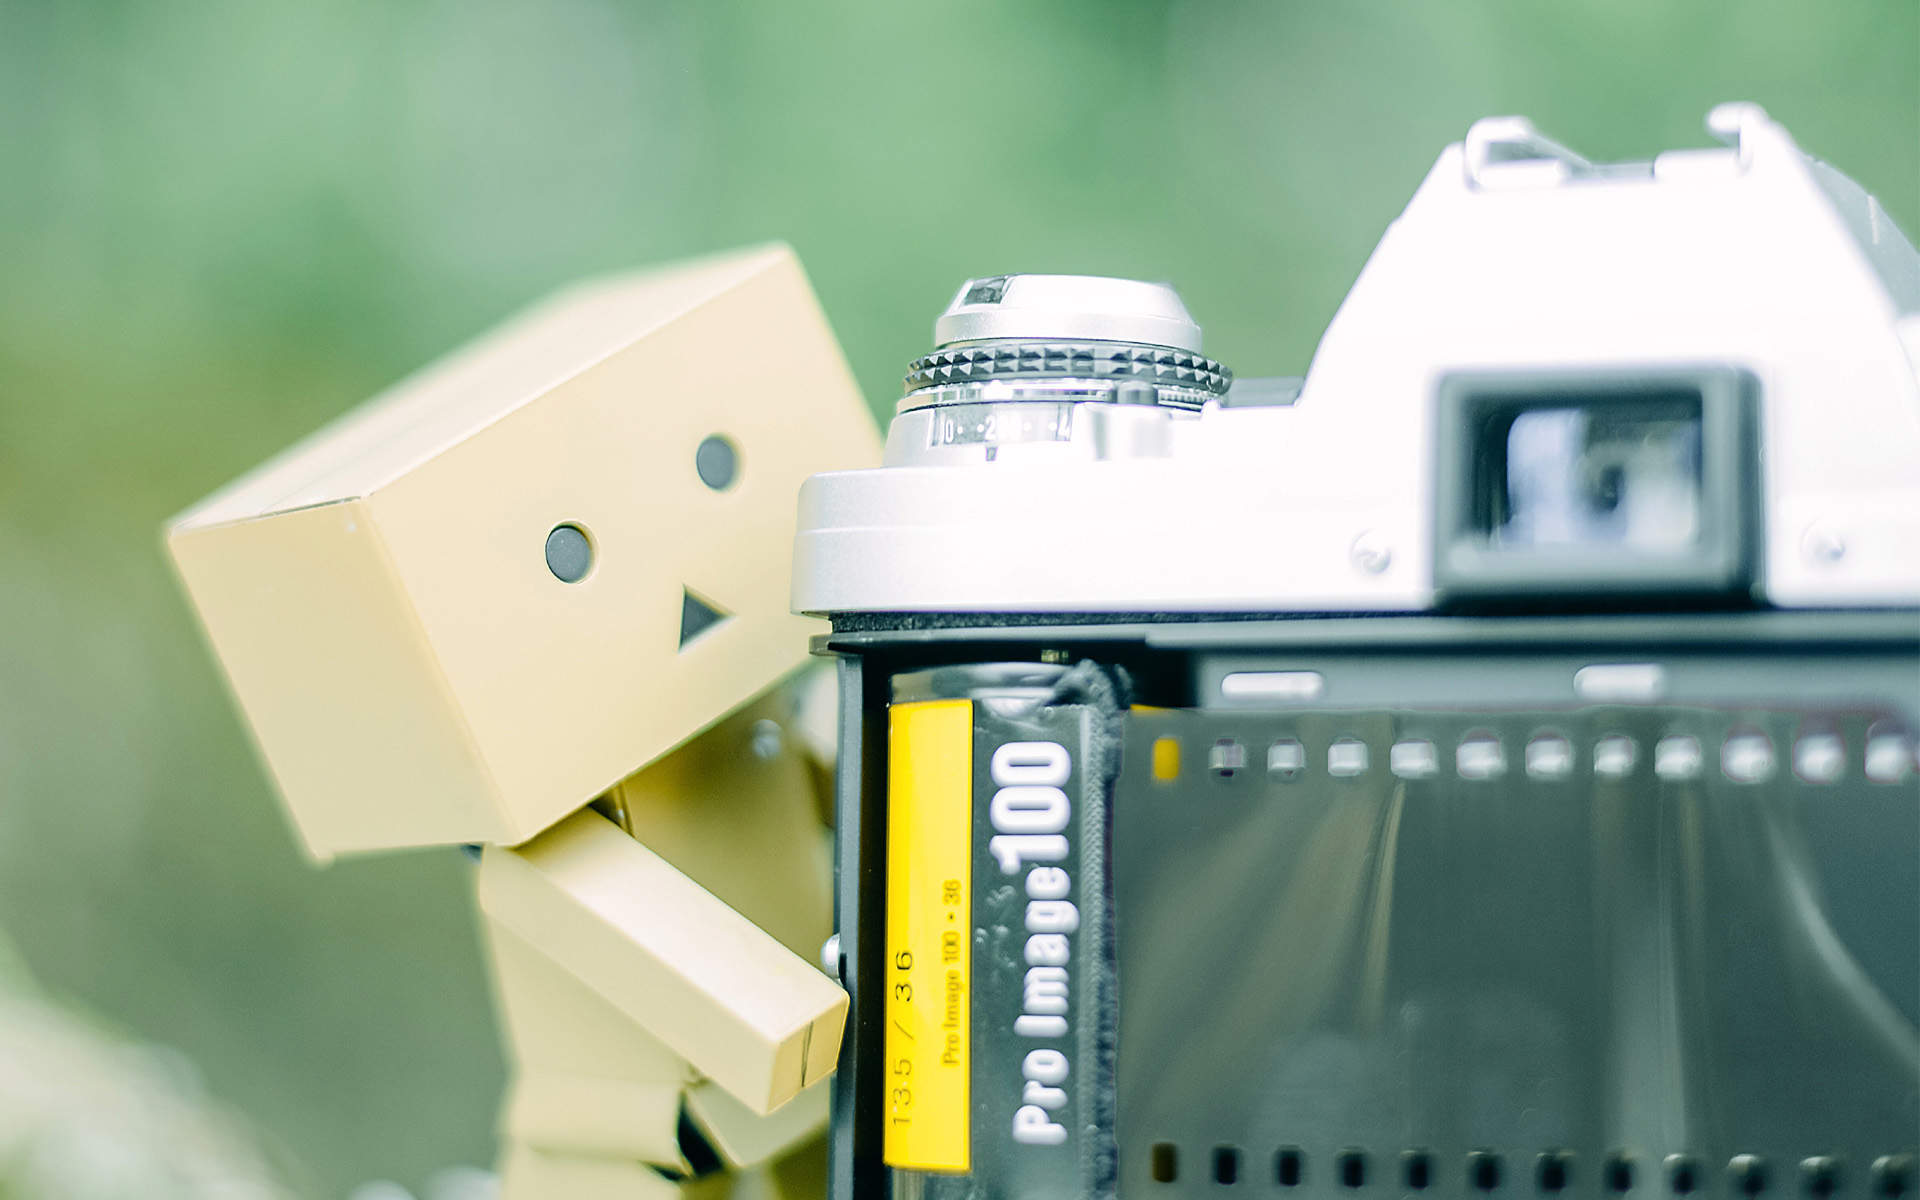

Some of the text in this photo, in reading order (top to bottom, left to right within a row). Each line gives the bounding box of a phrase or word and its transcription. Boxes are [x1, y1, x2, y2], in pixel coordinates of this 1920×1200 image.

[895, 951, 913, 1002] 36
[942, 879, 963, 1065] Pro Image 100 36
[1012, 1048, 1069, 1145] Pro
